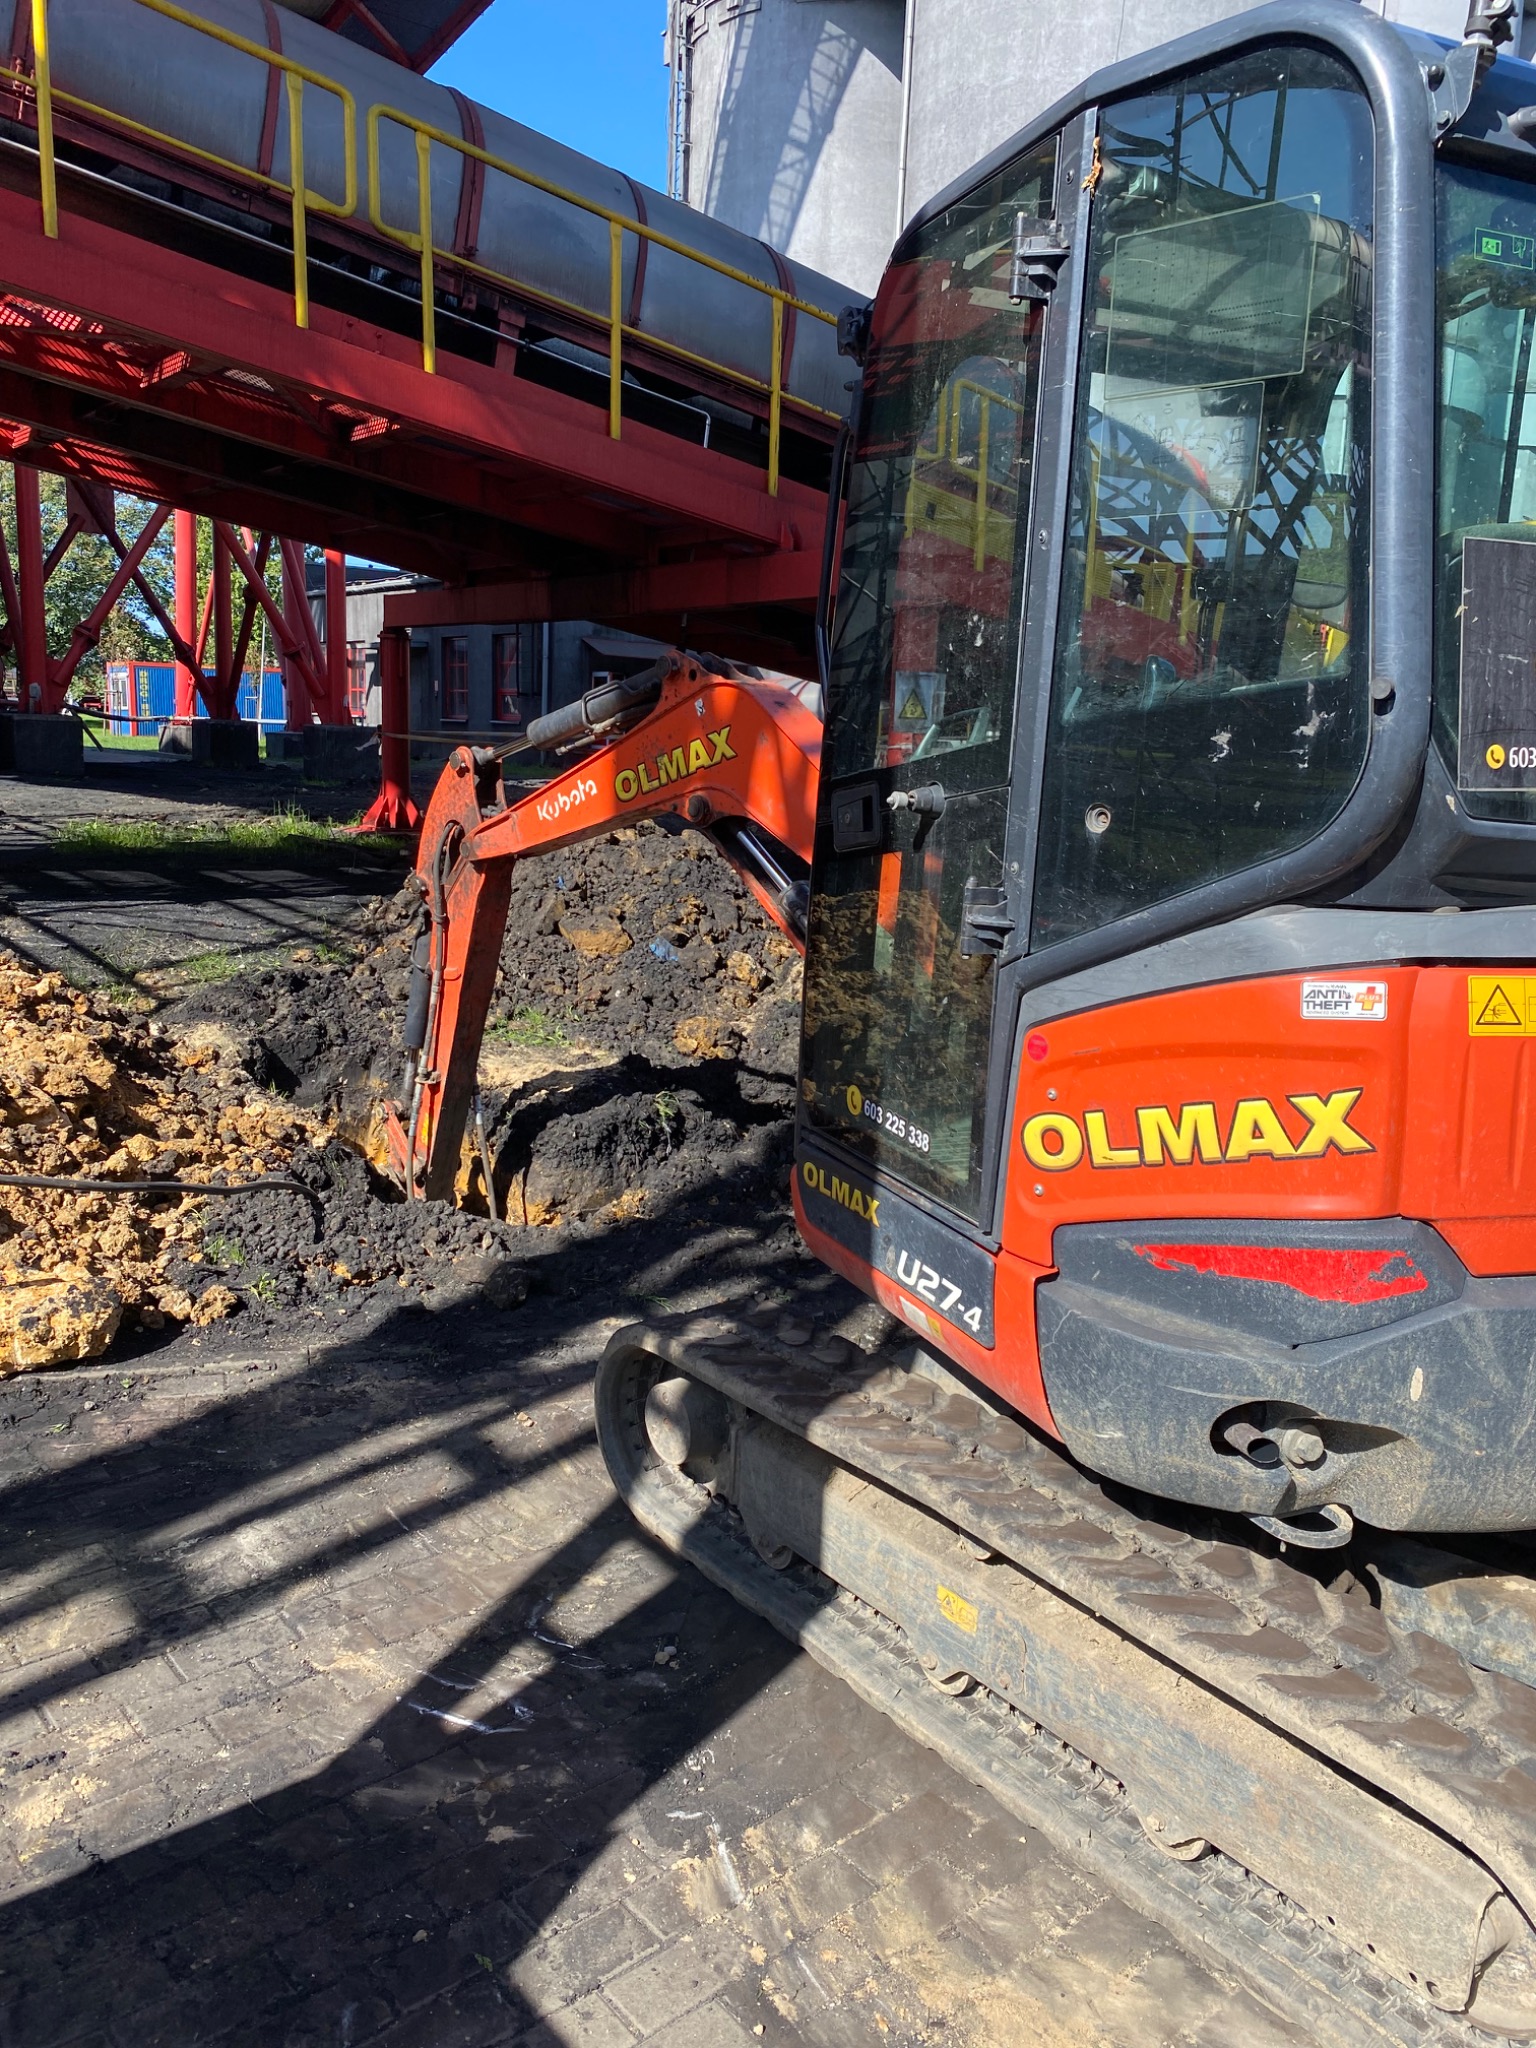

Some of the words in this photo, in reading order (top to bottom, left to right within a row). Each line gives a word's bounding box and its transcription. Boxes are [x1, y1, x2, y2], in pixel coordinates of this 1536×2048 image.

[615, 726, 737, 801] OLMAX
[1508, 746, 1536, 768] 603
[536, 779, 598, 821] Kubota
[1303, 1000, 1352, 1011] THEFT
[1304, 989, 1342, 999] ANTI
[863, 1099, 883, 1125] 603
[885, 1111, 906, 1138] 225
[908, 1125, 930, 1152] 338
[1021, 1086, 1377, 1172] OLMAX
[803, 1161, 880, 1228] OLMAX
[896, 1249, 982, 1333] U27-4
